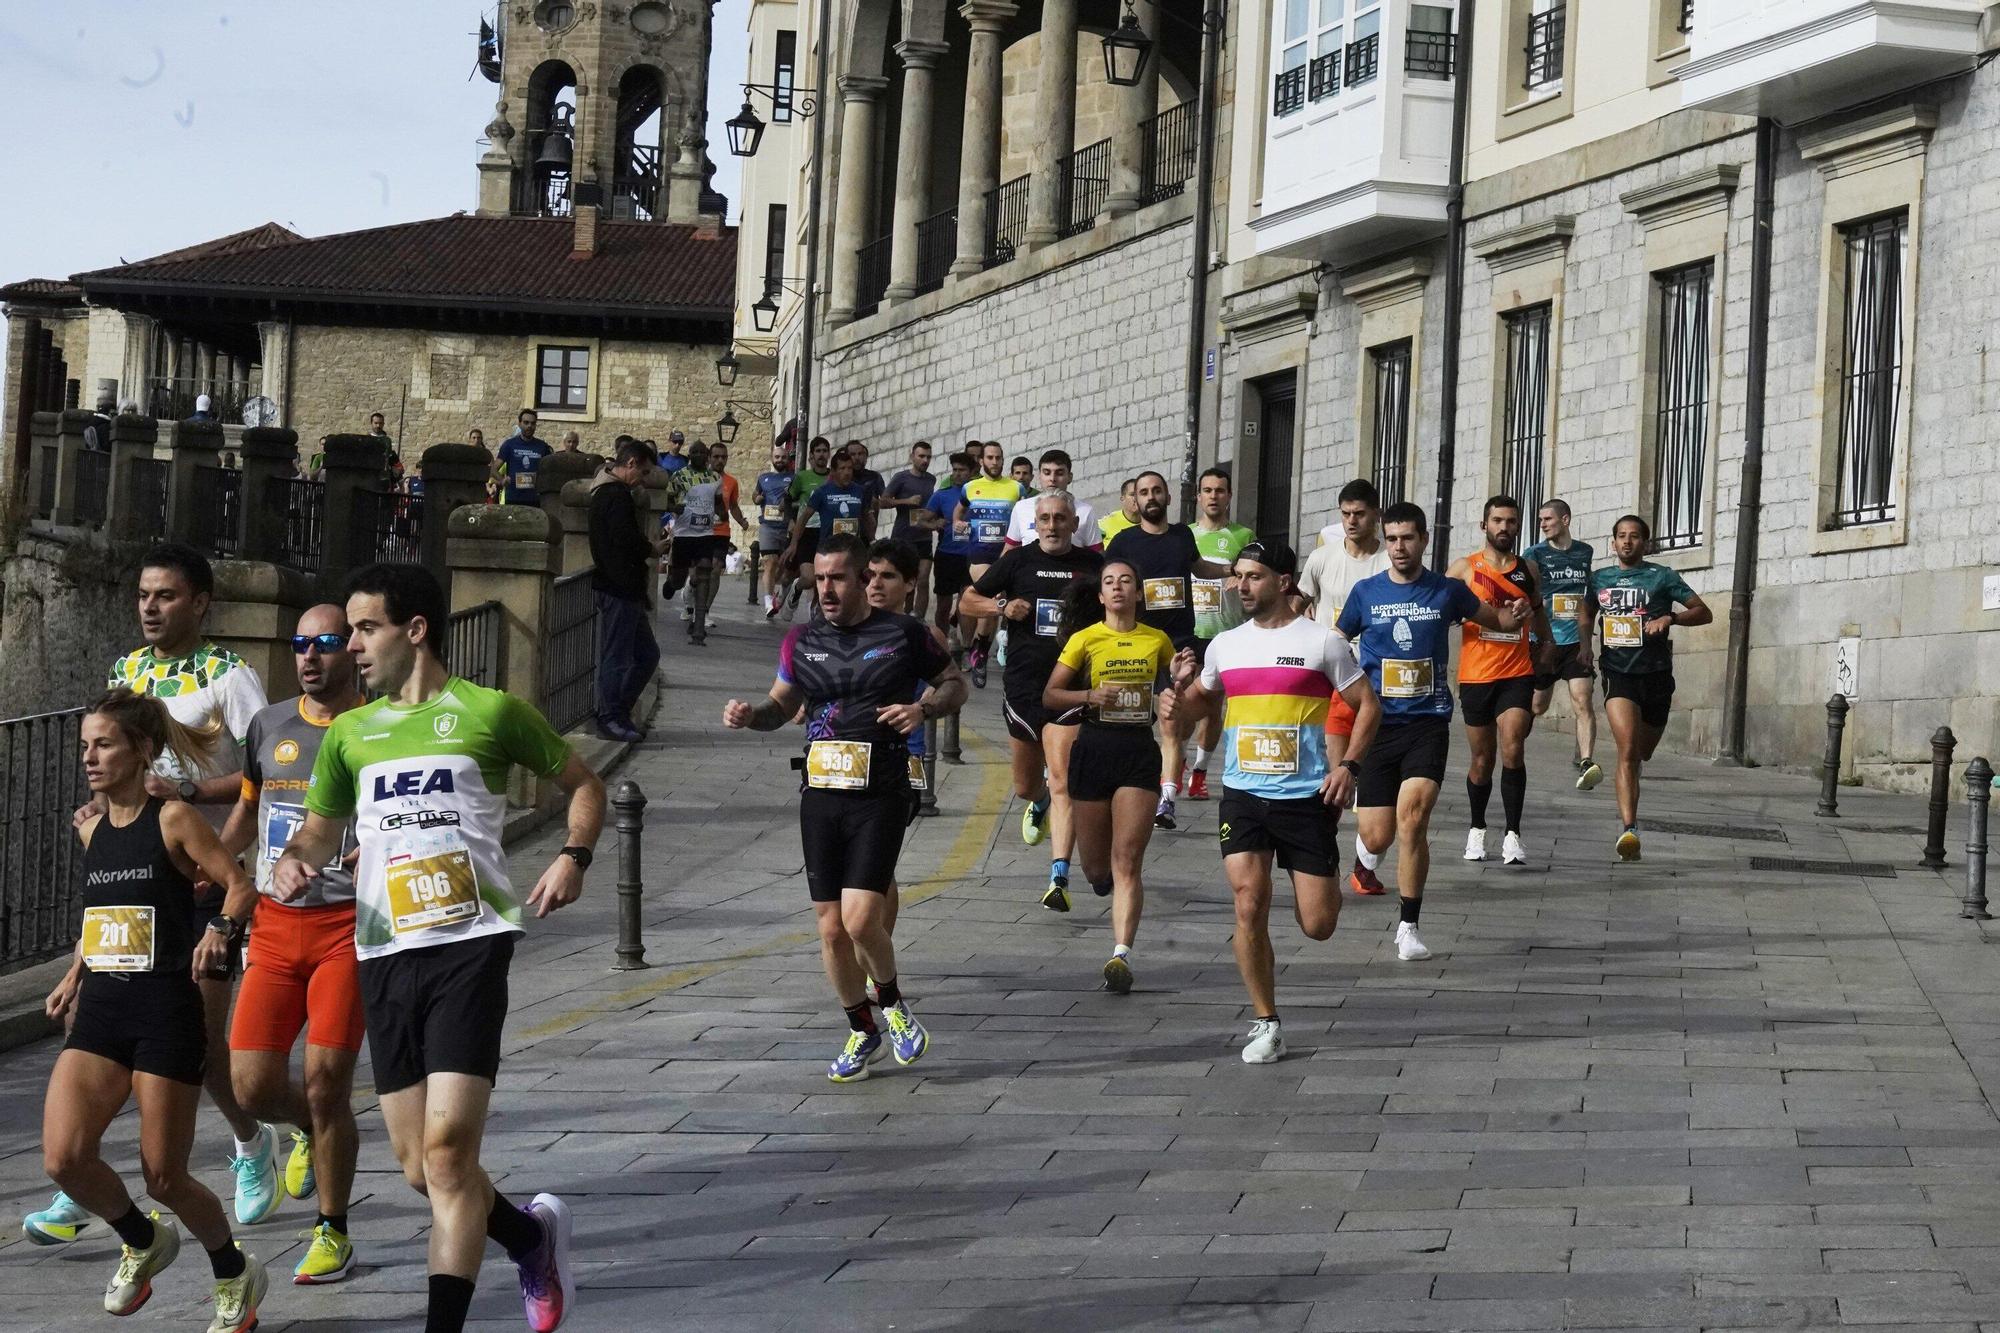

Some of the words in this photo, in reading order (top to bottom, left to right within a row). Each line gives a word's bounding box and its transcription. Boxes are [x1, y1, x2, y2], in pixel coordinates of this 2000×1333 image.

[1379, 602, 1418, 611] CONQUISTA
[1381, 606, 1432, 617] ALMENDRA
[1563, 600, 1578, 610] 157
[1612, 622, 1631, 635] 290
[1105, 658, 1149, 668] GAIKAR
[1276, 656, 1305, 666] 226ERS
[1398, 669, 1420, 683] 147
[1253, 739, 1281, 757] 145
[373, 768, 455, 802] LEA
[380, 810, 461, 831] Gama
[406, 871, 451, 904] 196
[99, 922, 129, 947] 201
